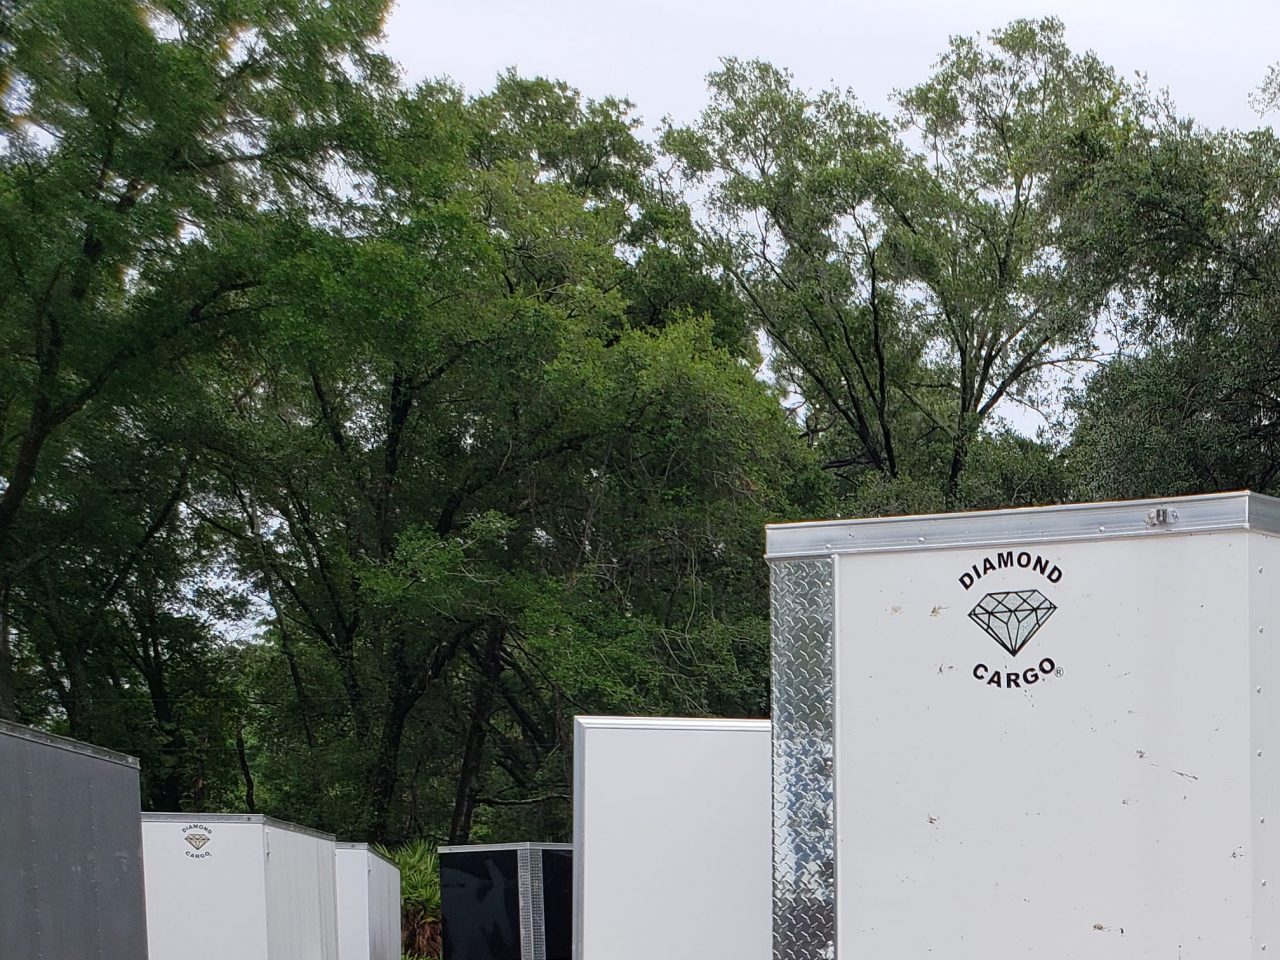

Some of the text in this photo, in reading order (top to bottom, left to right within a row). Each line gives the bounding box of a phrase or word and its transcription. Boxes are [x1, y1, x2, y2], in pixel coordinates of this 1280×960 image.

[958, 551, 1063, 591] DIAMOND
[181, 824, 213, 835] DIAMOND
[185, 851, 210, 859] CARGO
